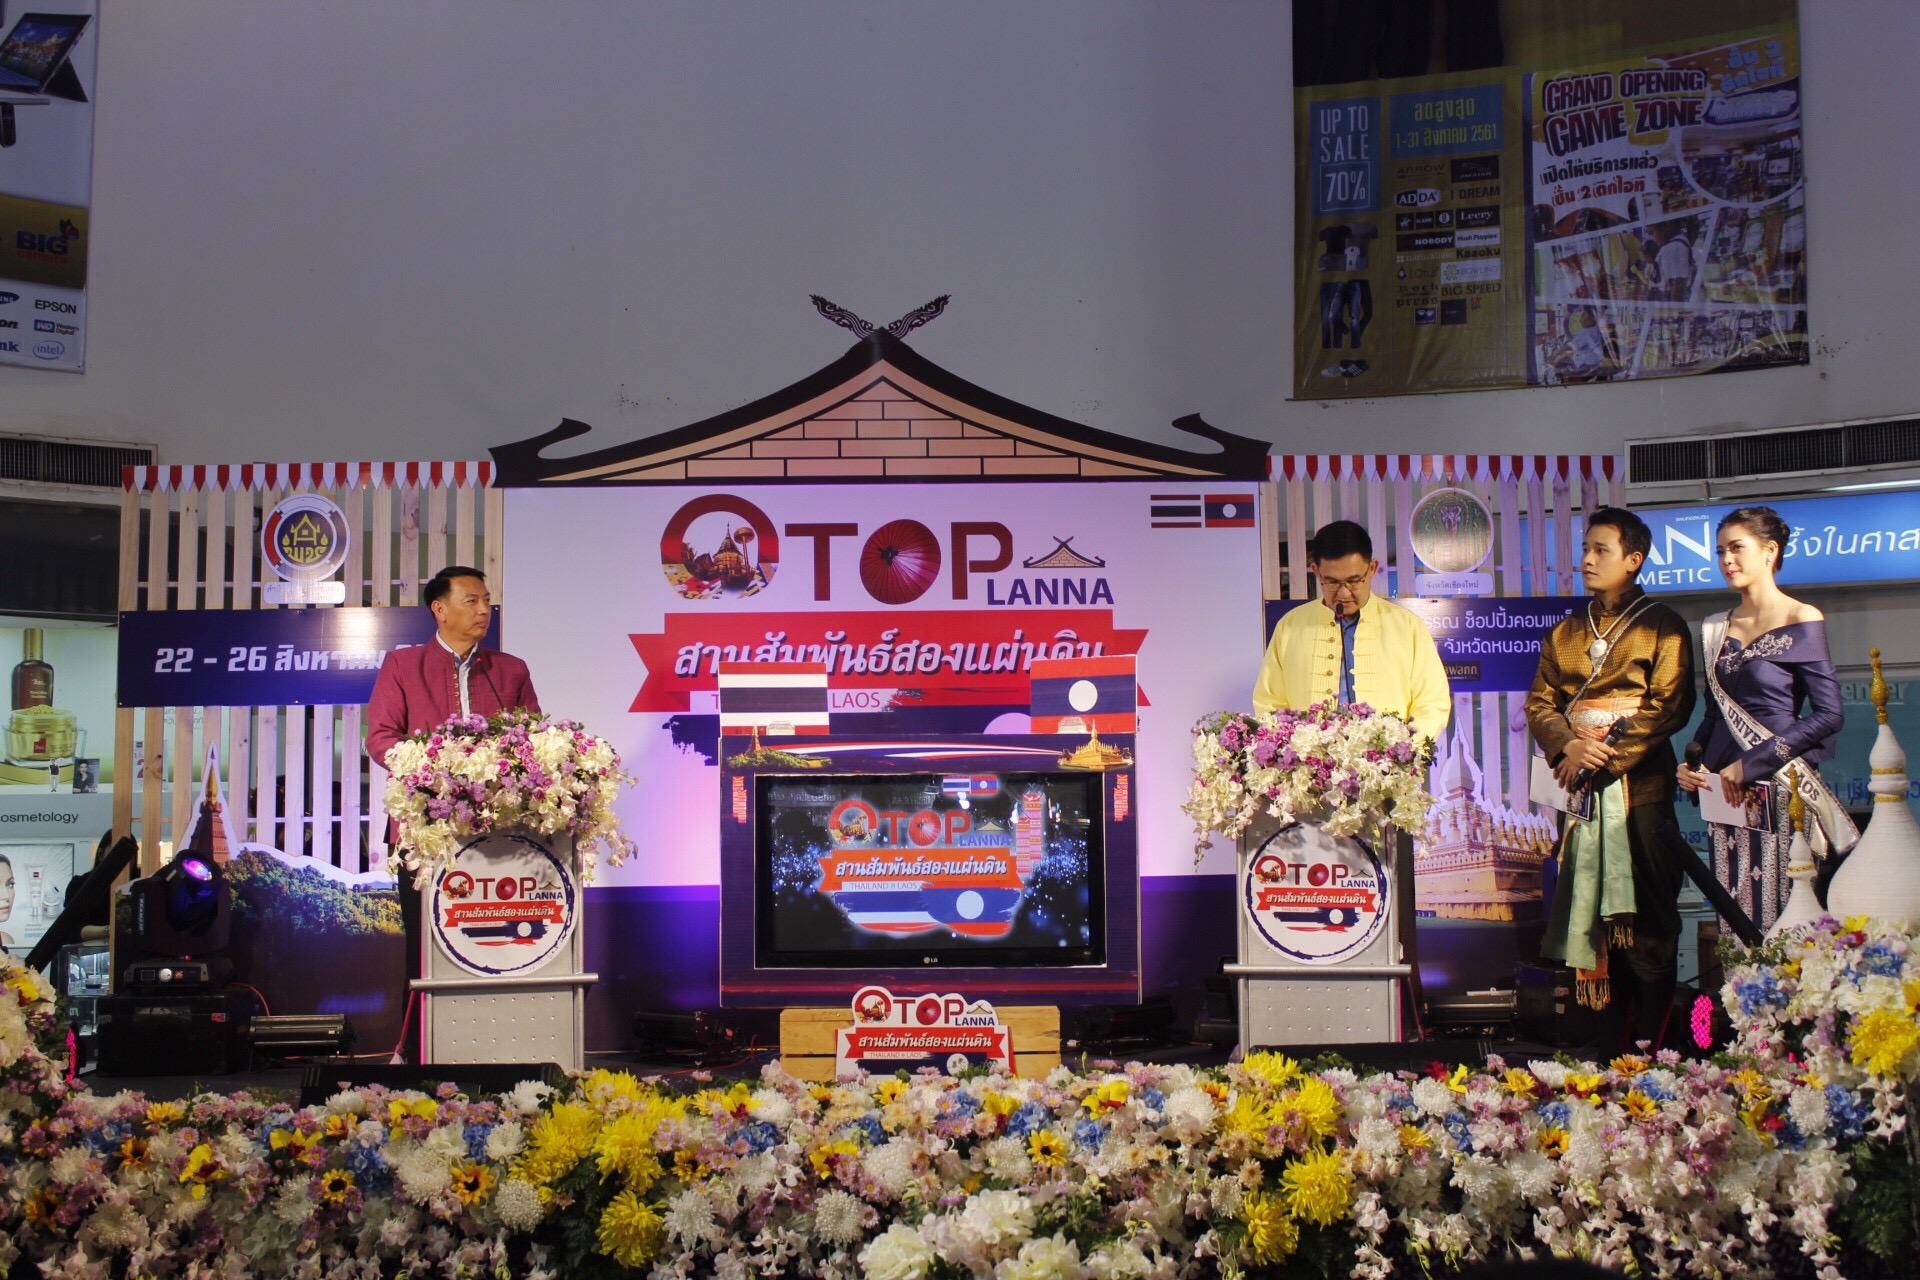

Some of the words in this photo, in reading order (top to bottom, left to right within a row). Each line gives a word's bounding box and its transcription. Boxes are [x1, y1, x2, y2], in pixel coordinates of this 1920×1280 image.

[1547, 75, 1613, 113] GRAND
[1619, 71, 1704, 98] OPENING
[1320, 108, 1342, 135] UP
[1347, 105, 1369, 132] TO
[1414, 98, 1475, 123] ลดสูงสุด
[1423, 127, 1467, 147] สิงหาคม
[1470, 123, 1497, 142] 2561
[1549, 104, 1627, 157] GAME
[1634, 99, 1703, 134] ZONE
[1320, 134, 1370, 163] SALE
[1540, 150, 1659, 185] เปิดให้บริการแล้ว
[1325, 170, 1367, 203] 70%
[1459, 185, 1501, 200] DREAM
[1578, 185, 1591, 200] 2
[1398, 192, 1436, 205] ADDA
[16, 229, 69, 256] BIG
[1414, 236, 1454, 246] NOBODY
[1441, 285, 1463, 297] BIG
[1466, 283, 1502, 295] SPEED
[35, 299, 77, 314] EPSON
[36, 344, 61, 355] intel
[660, 494, 1014, 606] OTOP
[1634, 567, 1712, 586] METIC
[986, 577, 1115, 606] LANNA
[1443, 637, 1542, 654] จังหวัดหนองค
[154, 647, 194, 673] 22
[227, 646, 267, 672] 26
[832, 692, 880, 708] LAOS
[1727, 705, 1768, 747] UNIVE
[1, 811, 79, 824] osmetology
[828, 798, 972, 847] OTOP
[959, 833, 1011, 847] LANNA
[835, 855, 1008, 877] สานสัมพันธ์สองแผ่นดิน
[1254, 855, 1349, 887] OTOP
[442, 870, 537, 901] OTOP
[850, 882, 889, 891] THAILAND
[897, 881, 918, 890] LAOS
[1340, 879, 1376, 888] LANNA
[528, 891, 564, 901] LANNA
[854, 989, 965, 1026] OTOP
[955, 1016, 996, 1026] LANNA
[858, 1032, 993, 1049] สานสัมพันธ์สองแผ่นดิน
